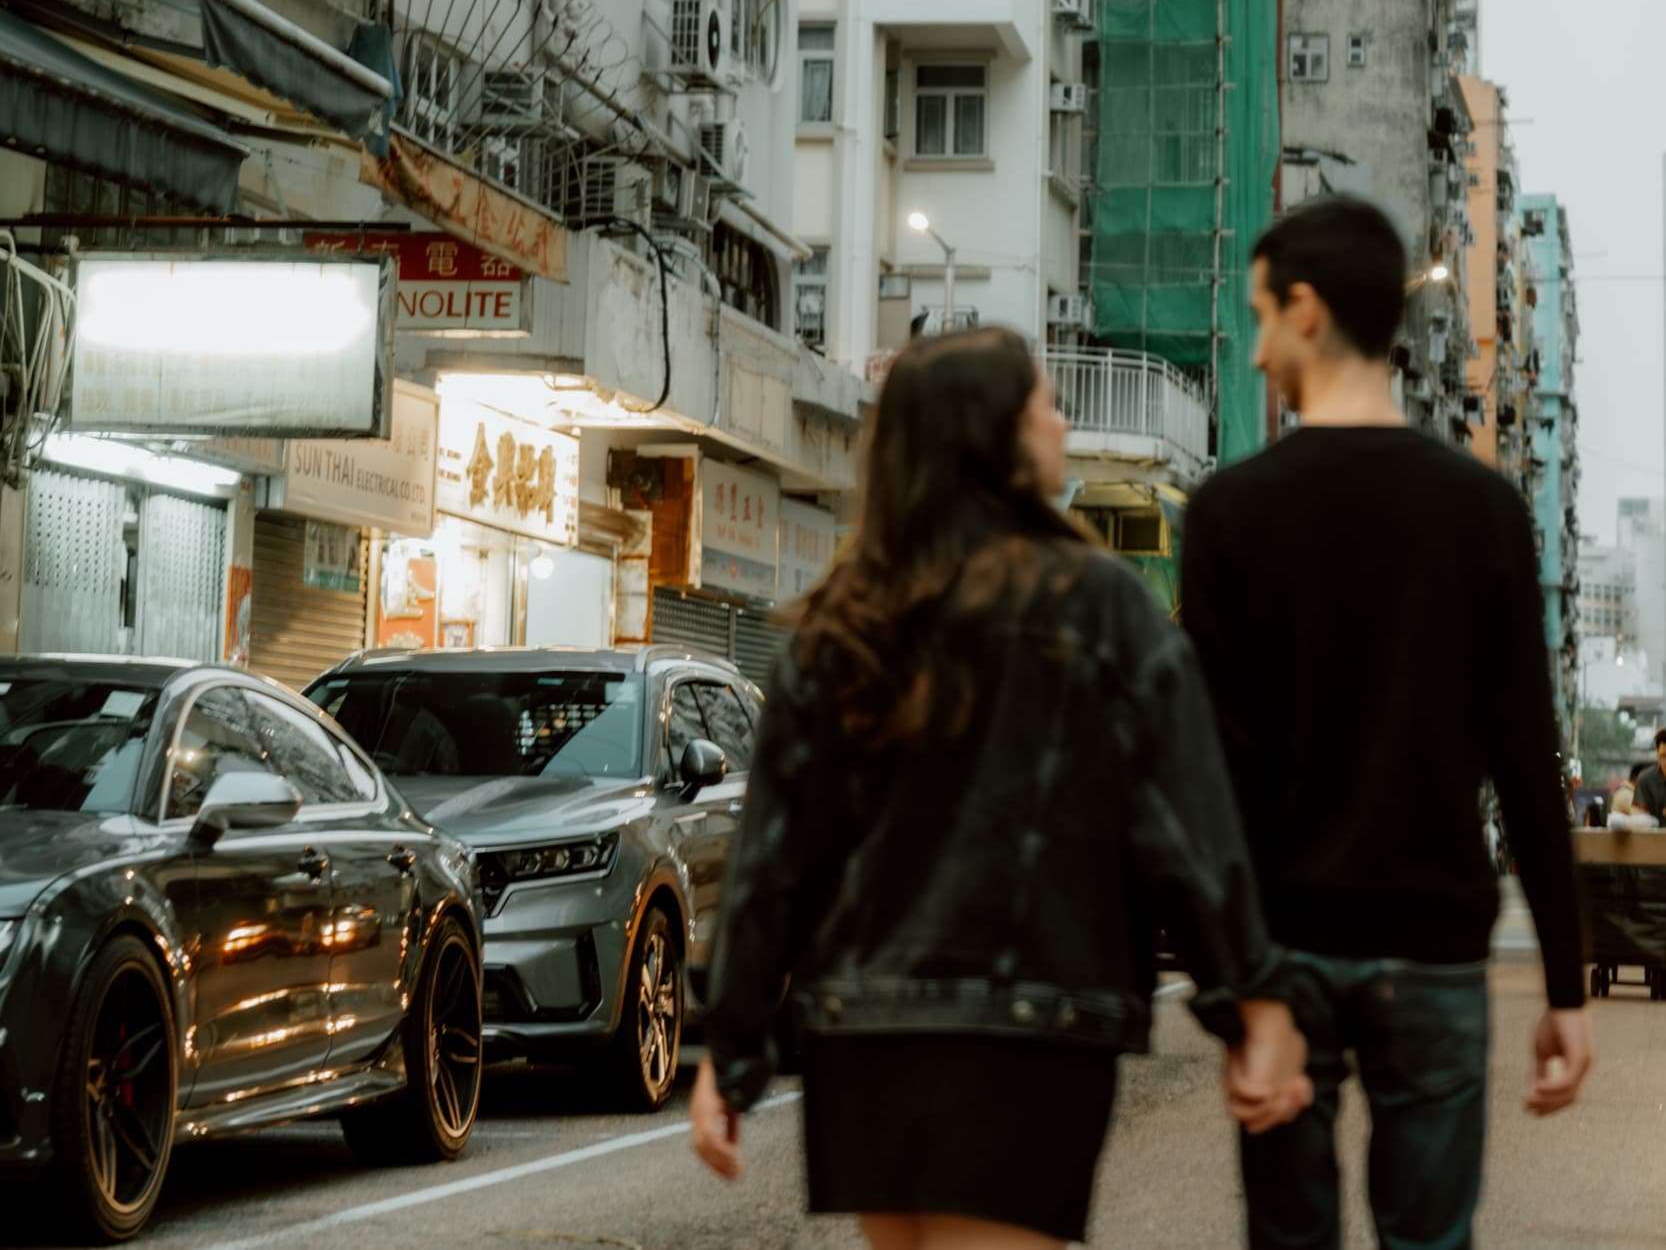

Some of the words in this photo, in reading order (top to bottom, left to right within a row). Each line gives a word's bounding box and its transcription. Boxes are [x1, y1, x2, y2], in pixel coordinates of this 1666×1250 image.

[295, 443, 322, 479] SUN
[326, 451, 354, 487] THAI
[357, 469, 399, 499] ELECTRICAL
